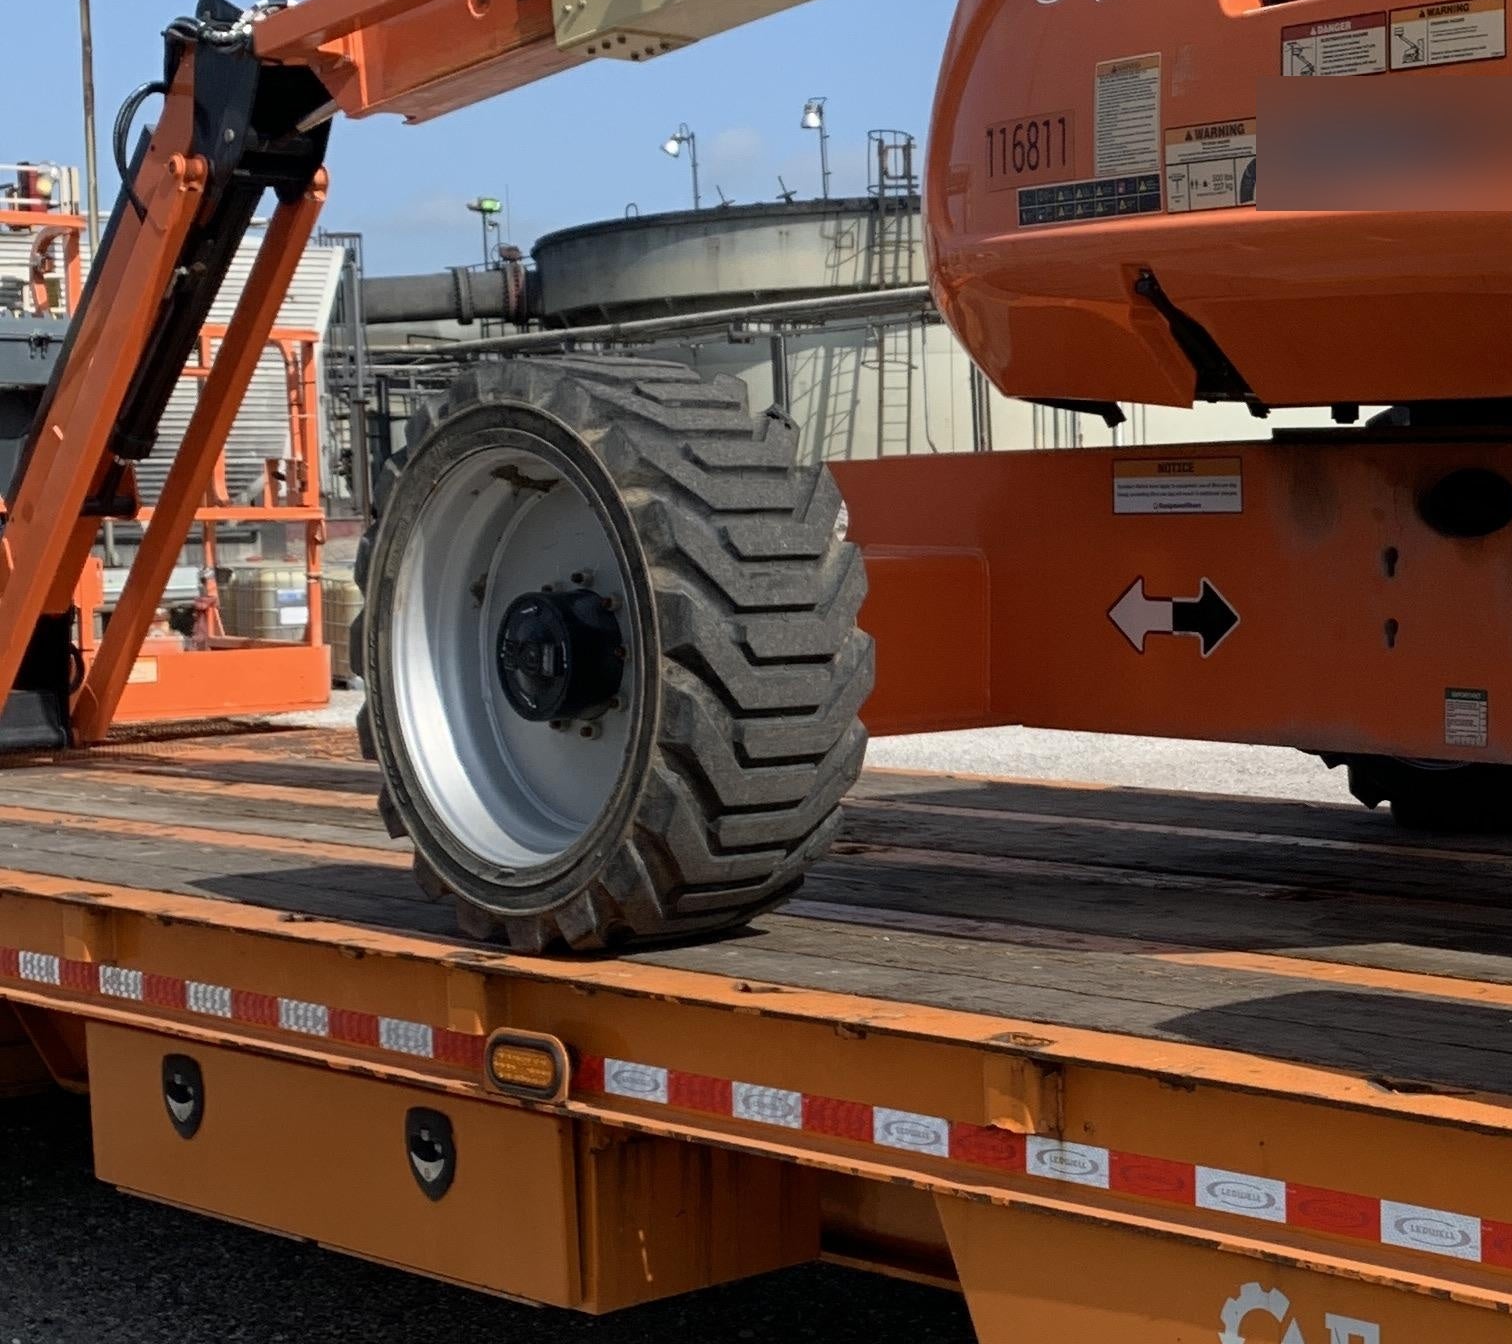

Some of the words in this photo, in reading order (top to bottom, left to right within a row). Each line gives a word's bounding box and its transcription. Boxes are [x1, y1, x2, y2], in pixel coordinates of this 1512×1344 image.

[1427, 3, 1470, 17] WARNING
[1317, 21, 1352, 35] DANGER
[1194, 123, 1245, 141] WARNING
[986, 116, 1067, 177] 116811
[1157, 462, 1194, 474] NOTICE
[1410, 1223, 1456, 1241] LEDWELL
